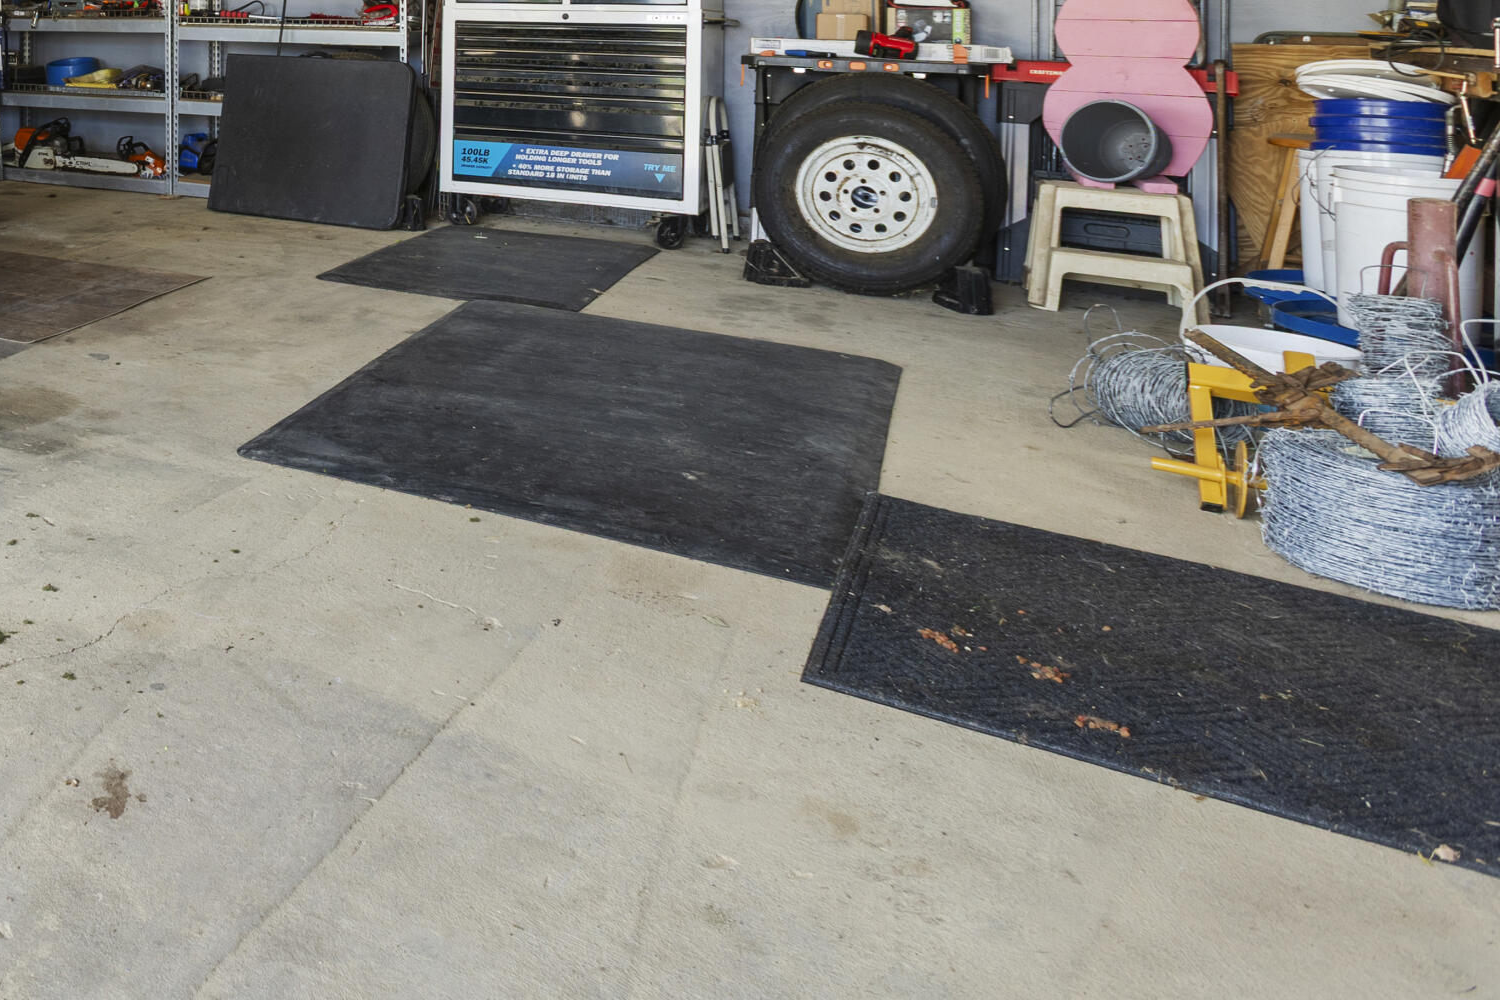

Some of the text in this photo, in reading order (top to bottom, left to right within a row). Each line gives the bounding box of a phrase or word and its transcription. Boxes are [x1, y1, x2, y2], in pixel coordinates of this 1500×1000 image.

[461, 147, 490, 157] 100LB
[526, 148, 548, 156] EXTRA
[550, 149, 570, 157] DEEP
[571, 151, 603, 160] DRAWER
[515, 154, 602, 166] HOLDING LONGER TOOLS
[533, 164, 556, 172] MORE
[556, 165, 590, 174] STORAGE
[591, 168, 611, 176] THAN
[644, 163, 676, 173] TRY ME
[507, 168, 545, 178] STANDARD
[556, 171, 565, 179] IN
[566, 173, 588, 181] UNITS
